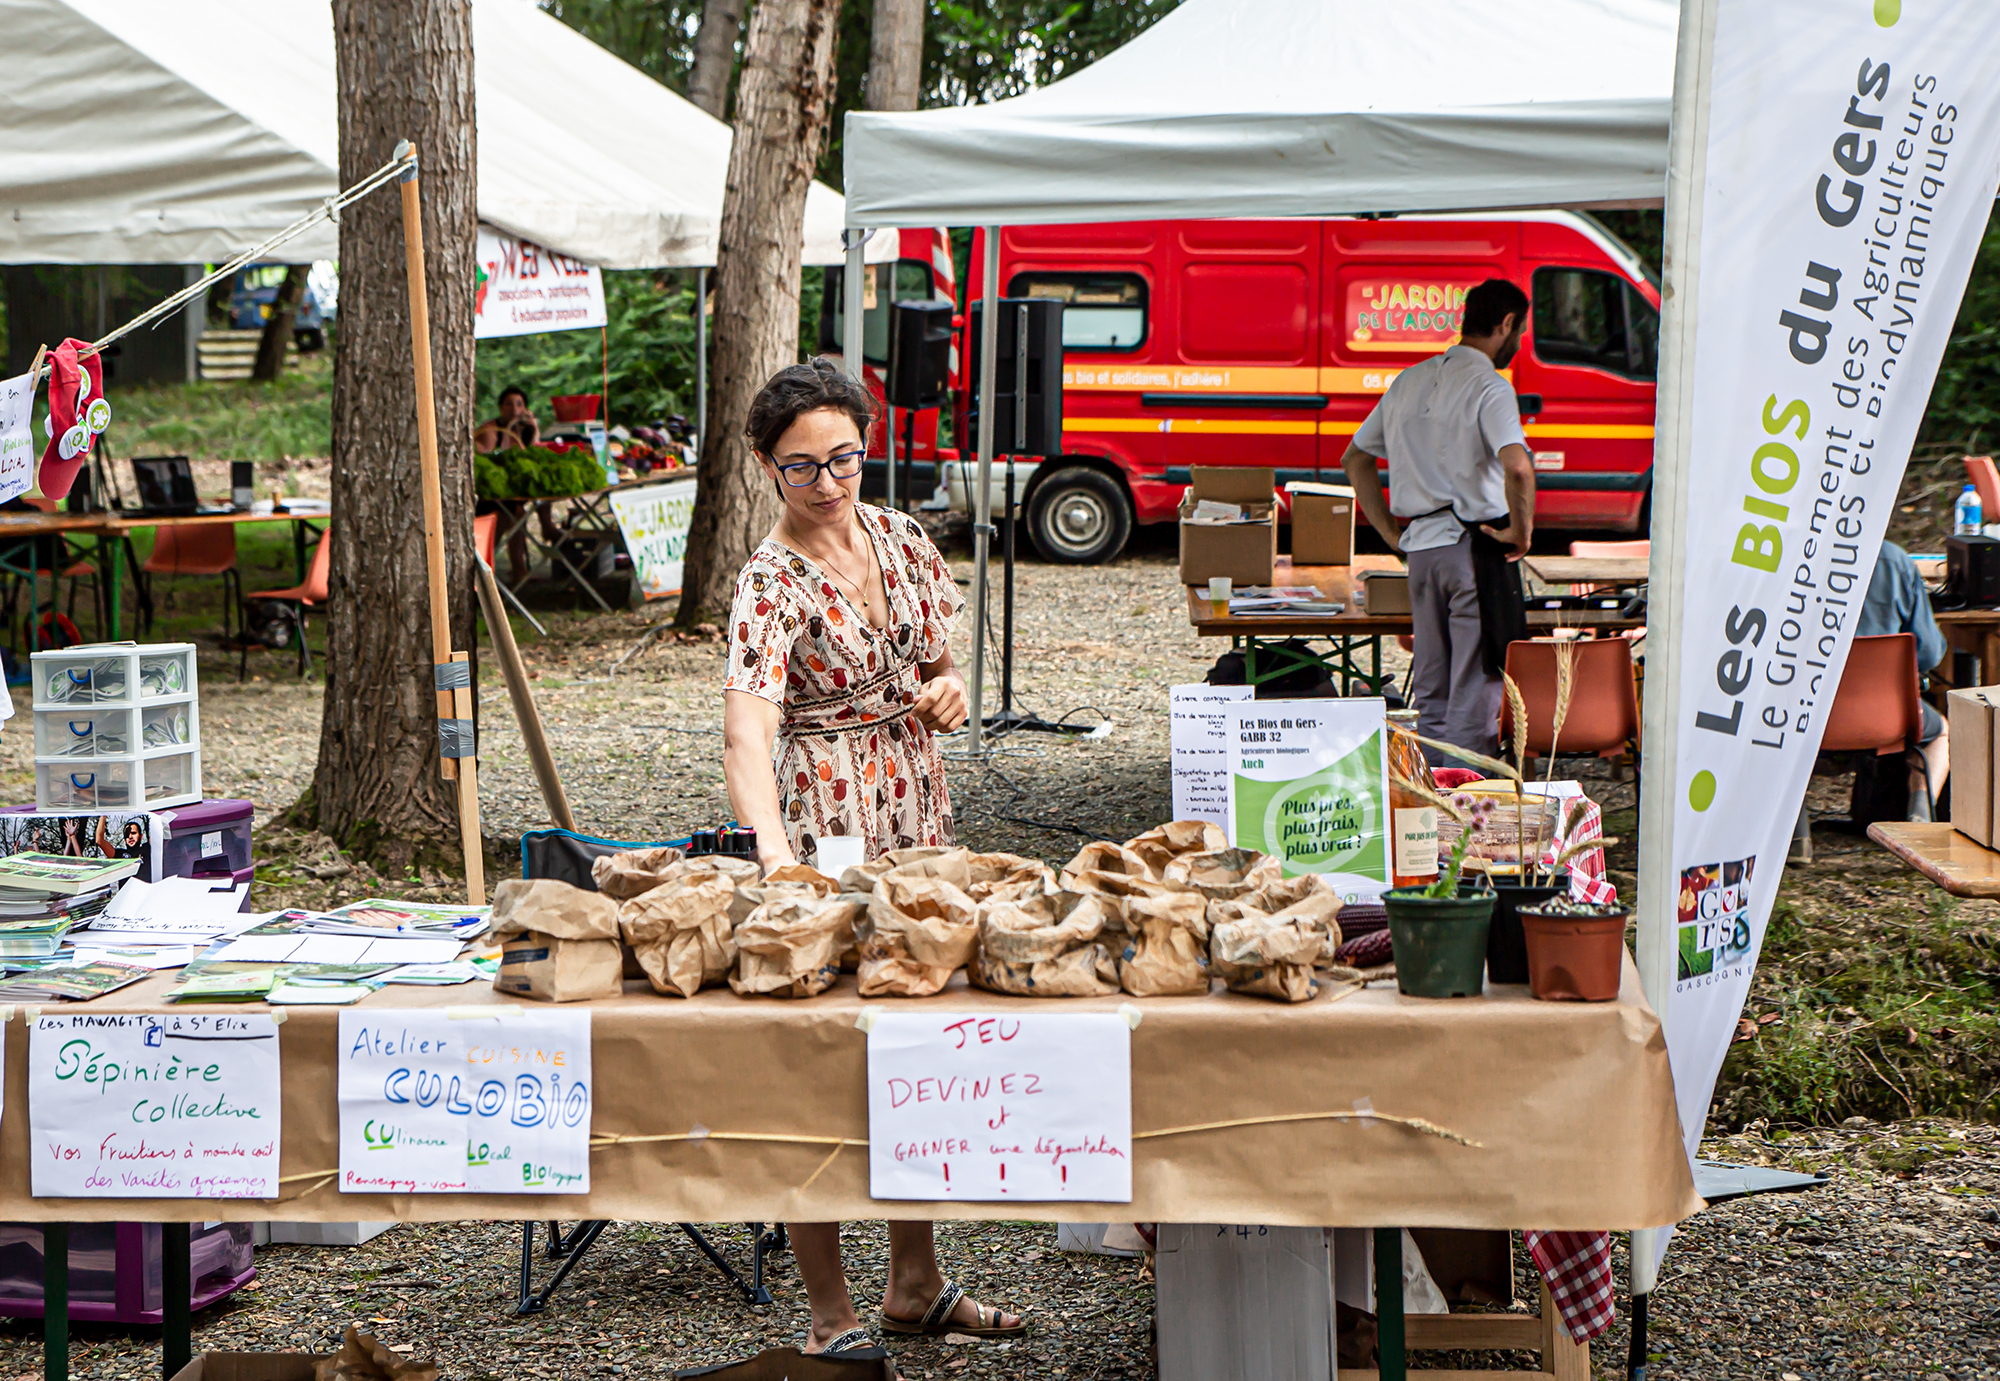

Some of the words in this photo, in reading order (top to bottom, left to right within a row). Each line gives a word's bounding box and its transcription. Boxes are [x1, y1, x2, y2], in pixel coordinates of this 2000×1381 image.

[1853, 73, 1936, 321] Agriculteurs
[1371, 283, 1471, 310] JARDIN
[1360, 312, 1380, 328] DE
[1076, 371, 1095, 384] bio
[1097, 372, 1110, 384] et
[1112, 371, 1172, 388] solidaires,
[1173, 371, 1223, 388] j'adhère
[1224, 371, 1230, 386] !
[1832, 337, 1868, 408] des
[1695, 605, 1766, 736] Les
[1731, 393, 1811, 573] BIOS
[1779, 260, 1842, 365] du
[1816, 57, 1890, 227] Gers
[1796, 495, 1865, 734] Biologiques
[1850, 439, 1874, 475] et
[1866, 102, 1957, 418] Biodynamiques
[1766, 426, 1852, 686] Groupement
[1240, 719, 1254, 729] Les
[1258, 719, 1278, 729] Bios
[1280, 718, 1293, 729] du
[1296, 718, 1316, 729] Gers
[1752, 706, 1788, 749] Le
[1240, 732, 1266, 742] GABB
[1269, 732, 1282, 742] 32
[1241, 759, 1264, 769] Auch
[1276, 747, 1310, 755] biologiques
[1281, 800, 1316, 816] Plus
[1319, 795, 1354, 816] près,
[1283, 821, 1315, 841] plus
[1316, 815, 1358, 837] frais,
[1285, 841, 1318, 861] plus
[1321, 834, 1352, 852] vrai
[1676, 966, 1753, 993] GASCOGNE
[39, 1018, 64, 1030] Les
[173, 1016, 181, 1031] à
[215, 1017, 249, 1031] Elix
[943, 1018, 1020, 1049] JEU
[351, 1027, 447, 1060] Atelier
[988, 1105, 1011, 1130] et
[49, 1143, 81, 1160] Vos
[183, 1141, 194, 1158] à
[203, 1142, 245, 1158] moindre
[252, 1141, 275, 1157] coût
[894, 1138, 971, 1161] GAGNER
[990, 1143, 1024, 1155] une
[1034, 1135, 1125, 1165] dégustation
[85, 1166, 113, 1189] des
[190, 1175, 266, 1188] anciennes
